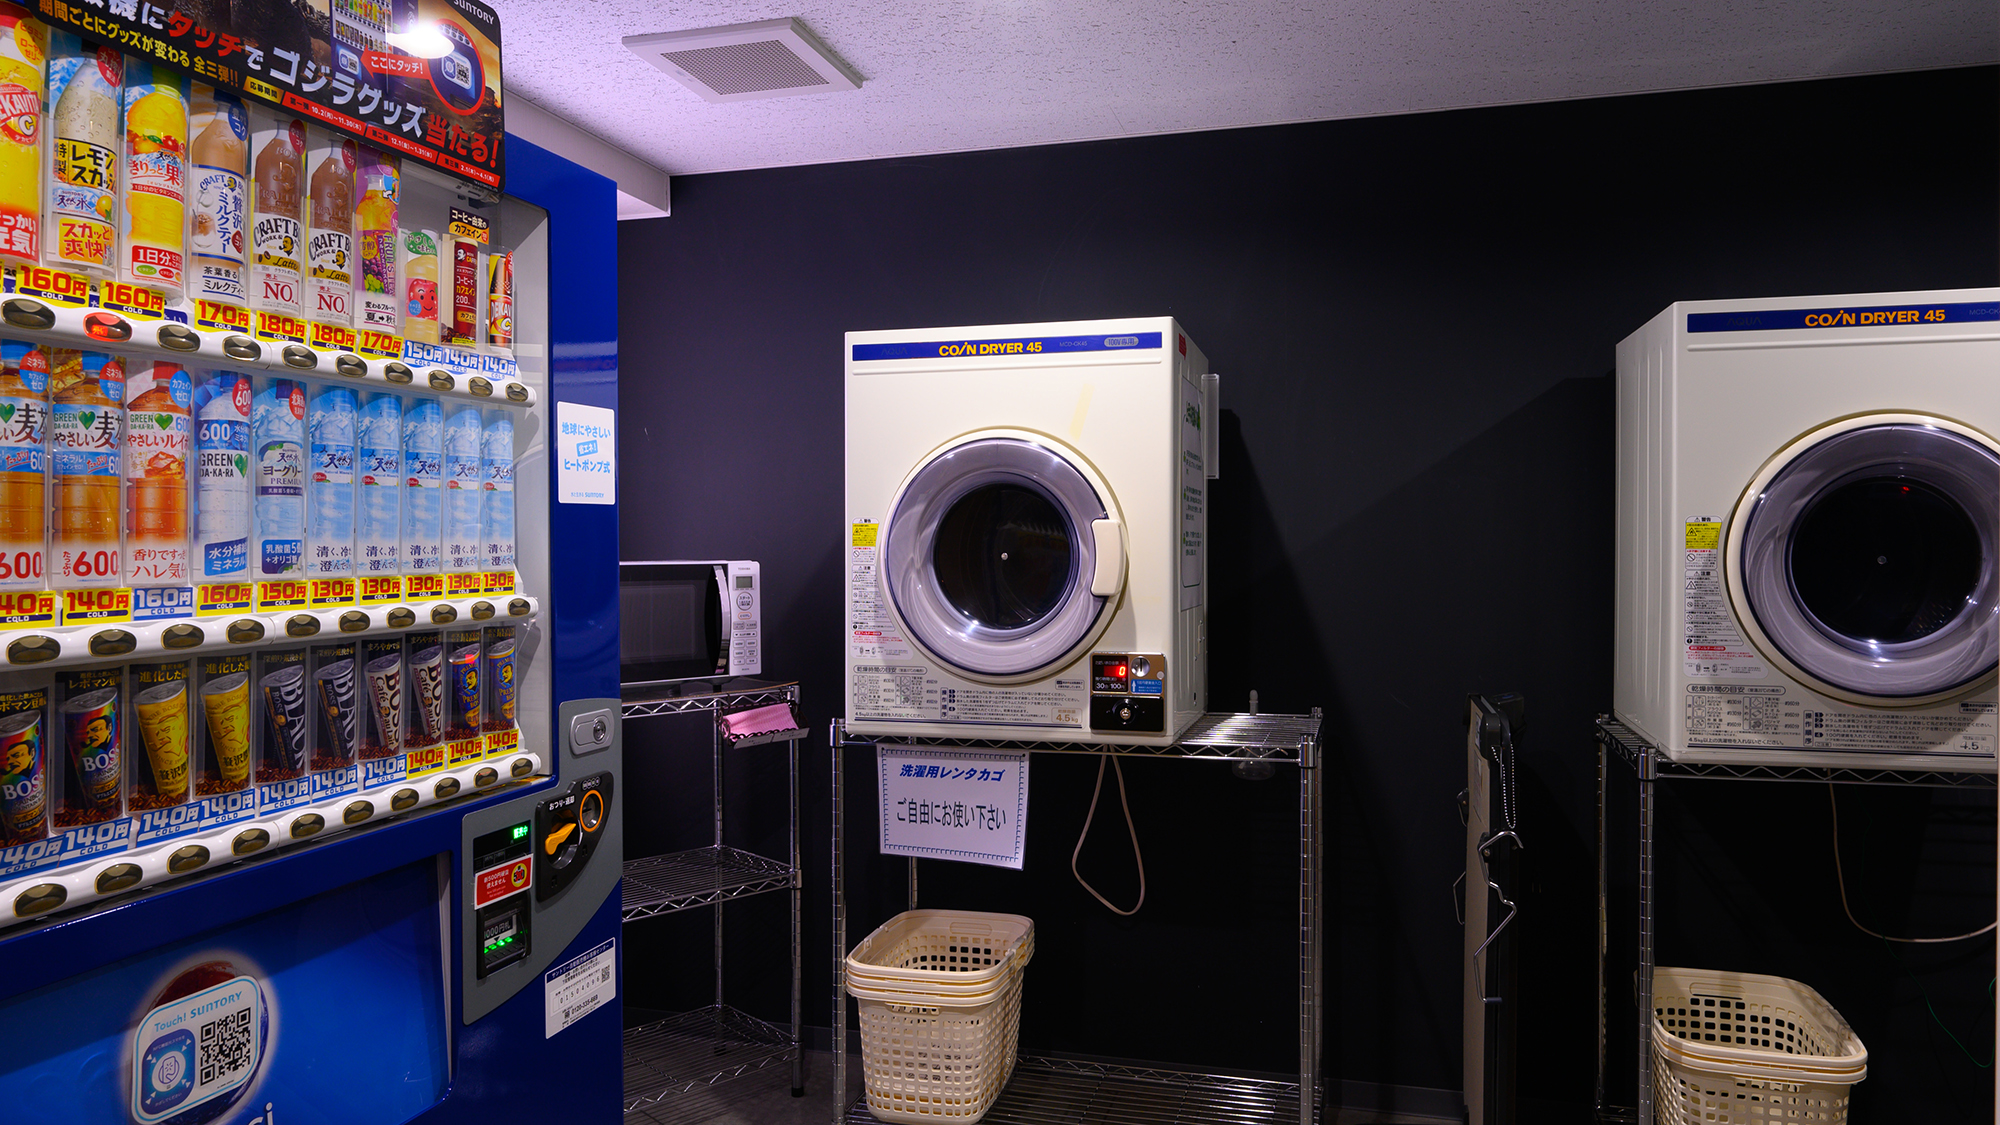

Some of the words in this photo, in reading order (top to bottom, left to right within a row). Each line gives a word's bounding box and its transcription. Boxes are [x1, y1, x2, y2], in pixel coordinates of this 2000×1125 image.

[371, 56, 424, 74] ここにタッチ!
[217, 193, 232, 254] ミルクティー
[452, 210, 487, 228] コーヒー由来の
[254, 218, 293, 248] CRAFT
[454, 223, 481, 239] カフェイン
[309, 233, 345, 260] CRAFT
[21, 266, 86, 296] 160円
[41, 291, 64, 301] COLD
[106, 281, 162, 310] 160円
[123, 306, 143, 314] COLD
[198, 300, 248, 326] 170円
[1860, 311, 1920, 324] DRYER
[1924, 309, 1946, 322] 45
[214, 322, 232, 330] COLD
[260, 313, 305, 337] 180円
[314, 324, 354, 346] 180円
[363, 331, 401, 352] 170円
[406, 341, 442, 362] 150円
[980, 342, 1023, 354] DRYER
[1026, 341, 1043, 353] 45
[445, 349, 478, 368] 140円
[485, 356, 516, 375] 140円
[452, 365, 468, 373] COLD
[31, 380, 44, 389] ゼロ
[54, 412, 77, 422] GREEN
[130, 413, 154, 422] GREEN
[199, 423, 230, 440] 600
[562, 422, 611, 438] 地球にやさしい
[199, 453, 233, 467] GREEN
[564, 458, 610, 473] ヒートポンプ式
[72, 550, 118, 577] 600
[362, 578, 400, 594] 130円
[408, 575, 443, 592] 130円
[448, 574, 481, 588] 130円
[484, 573, 514, 586] 130円
[202, 585, 251, 603] 160円
[261, 583, 306, 600] 150円
[312, 580, 353, 597] 130円
[66, 591, 129, 612] 140円
[136, 589, 191, 607] 160円
[150, 607, 175, 615] COLD
[1056, 714, 1070, 722] 4.5
[449, 740, 482, 756] 140円
[488, 732, 518, 747] 140円
[1960, 741, 1979, 750] 4.5
[409, 750, 443, 768] 140円
[367, 758, 406, 778] 140円
[900, 764, 1006, 781] 洗濯用レンタカゴ
[314, 769, 356, 789] 140円
[377, 774, 394, 783] COLD
[262, 781, 309, 803] 140円
[325, 786, 344, 795] COLD
[202, 792, 253, 818] 140円
[274, 798, 295, 808] COLD
[143, 805, 198, 831] 140円
[215, 812, 238, 822] COLD
[897, 798, 1006, 831] ご自由にお使い下さい
[66, 822, 129, 850] 140円
[155, 826, 180, 836] COLD
[80, 843, 108, 855] COLD
[5, 861, 37, 873] COLD
[155, 1013, 186, 1032] Touch!
[190, 991, 242, 1019] SUNTORY
